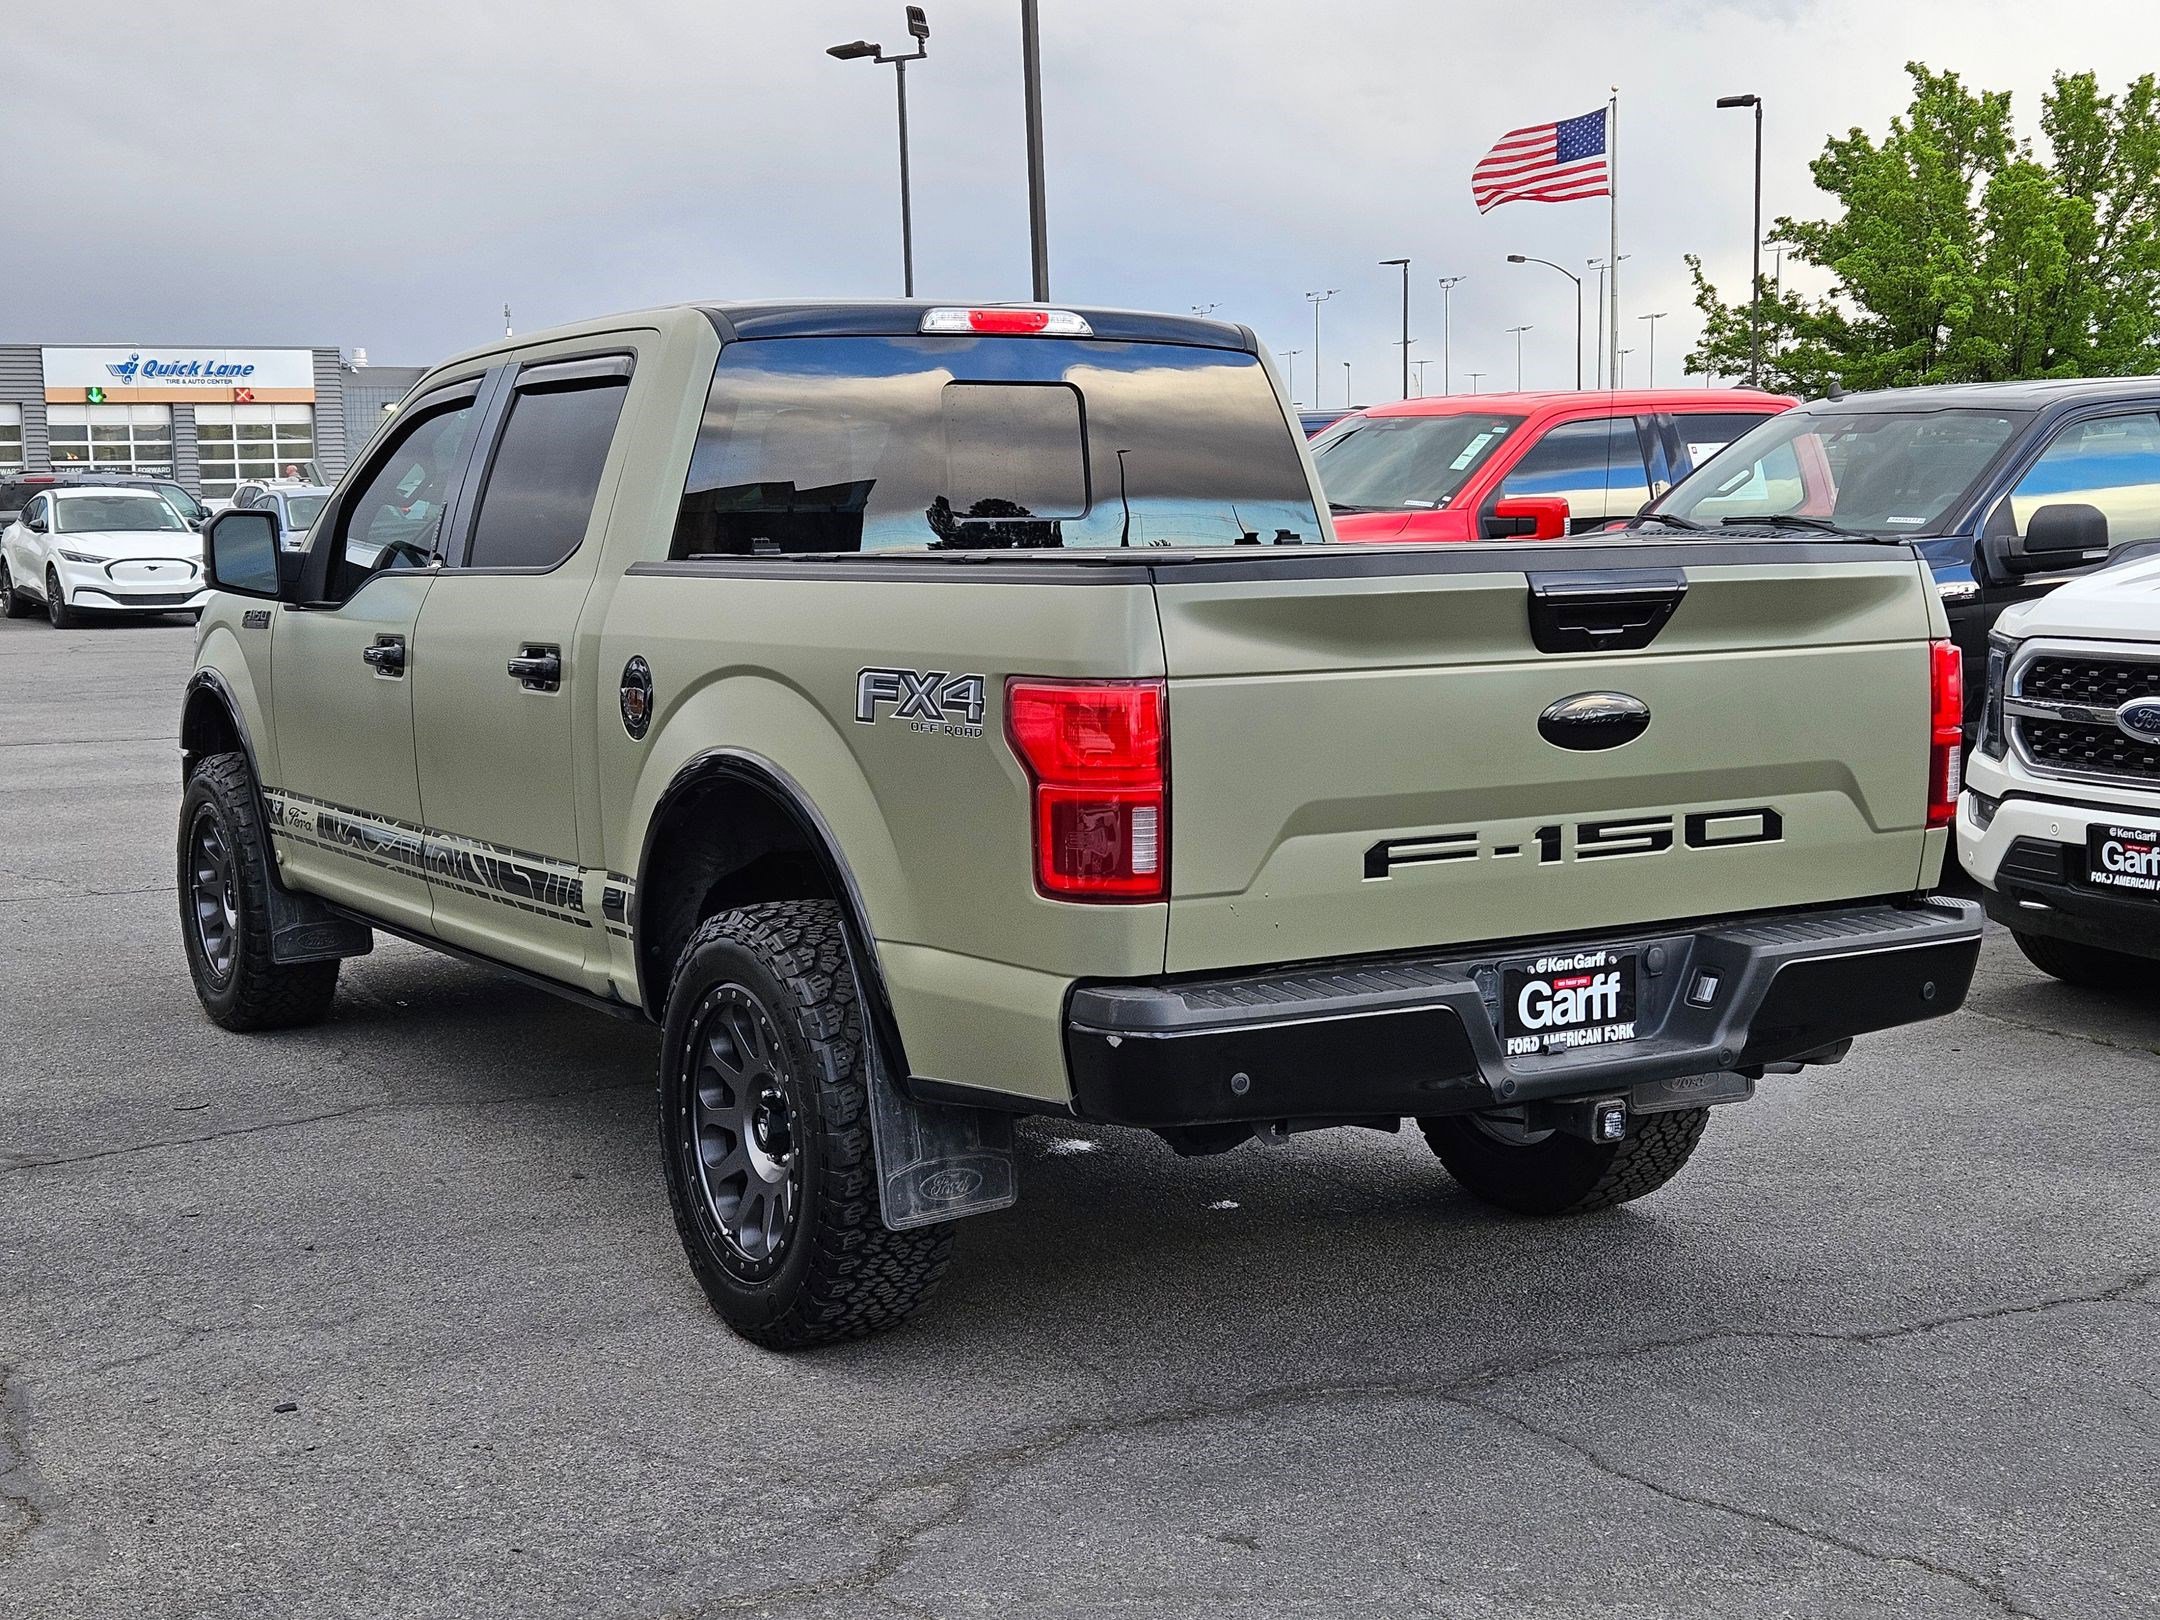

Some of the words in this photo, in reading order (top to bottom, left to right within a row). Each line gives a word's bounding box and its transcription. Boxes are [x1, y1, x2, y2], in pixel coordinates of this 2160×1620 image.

[141, 359, 201, 378] Quick
[201, 360, 255, 378] Lane
[137, 466, 171, 474] FORWARD
[854, 666, 986, 727] FX4
[2134, 708, 2160, 728] For
[910, 721, 939, 734] OFF
[943, 725, 983, 738] ROAD
[1362, 805, 1785, 882] F-150
[2117, 828, 2135, 839] Ken
[2135, 830, 2157, 842] Garff
[2102, 841, 2160, 876] Garf
[2091, 871, 2113, 884] FORD
[2113, 875, 2156, 890] AMERICAN
[1547, 957, 1573, 972] Ken
[1573, 951, 1606, 969] Garff
[1518, 971, 1620, 1030] Garff
[1507, 1037, 1540, 1055] FORD
[1543, 1028, 1602, 1047] AMERICAN
[1604, 1023, 1635, 1042] FORK
